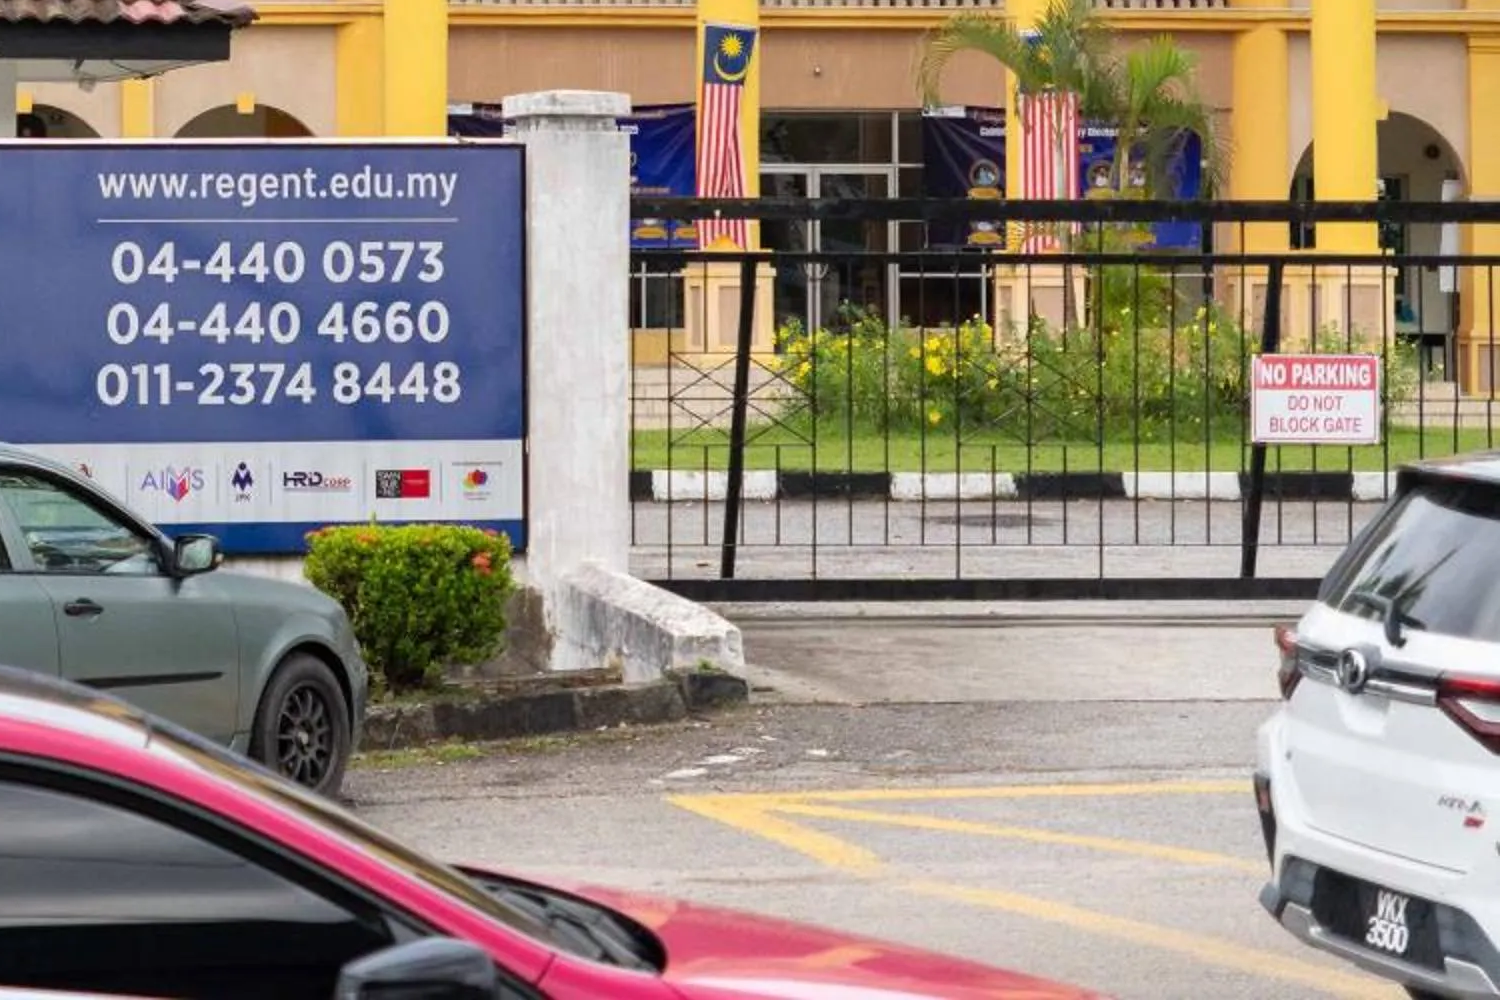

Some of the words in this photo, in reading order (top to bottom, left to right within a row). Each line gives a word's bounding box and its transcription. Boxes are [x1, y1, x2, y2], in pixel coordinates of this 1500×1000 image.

[97, 164, 459, 208] www.regent.edu.my
[111, 241, 306, 284] 04-440
[322, 240, 445, 284] 0573
[106, 301, 301, 345] 04-440
[317, 300, 450, 344] 4660
[97, 362, 317, 406] 011-2374
[333, 361, 461, 404] 8448
[1261, 362, 1286, 385] NO
[1292, 363, 1372, 386] PARKING
[1287, 396, 1309, 411] DO
[1314, 396, 1344, 411] NOT
[1269, 417, 1319, 433] BLOCK
[1323, 417, 1362, 433] GATE
[1366, 916, 1409, 953] 3500
